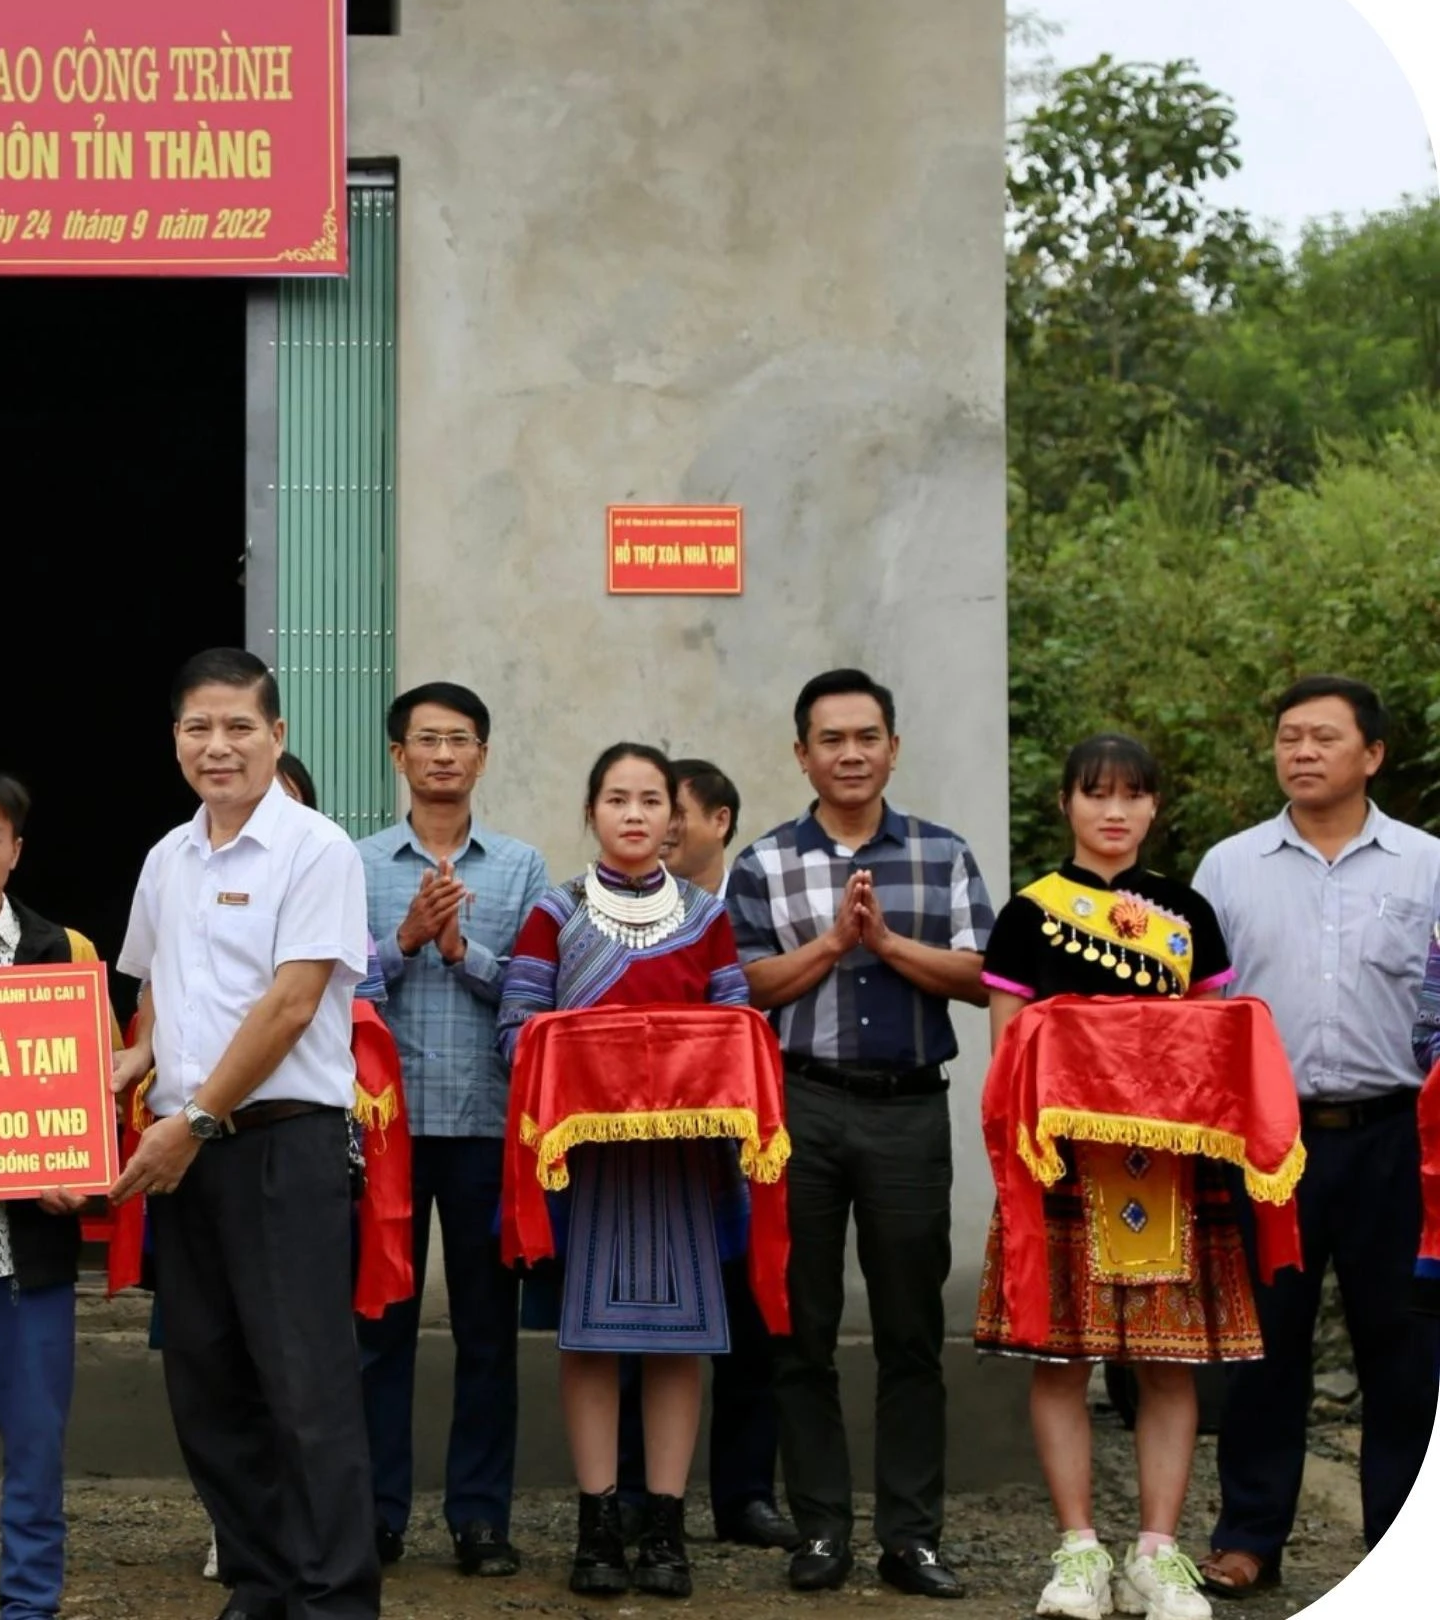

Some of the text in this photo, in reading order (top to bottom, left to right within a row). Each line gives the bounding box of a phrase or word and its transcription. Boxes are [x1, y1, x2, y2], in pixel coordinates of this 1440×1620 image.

[52, 28, 160, 104] CÔNG
[169, 29, 293, 102] TRÌNH
[71, 112, 133, 180] TỈN
[145, 120, 272, 180] THÀNG
[20, 209, 51, 240] 24
[62, 207, 129, 244] tháng
[130, 208, 149, 240] 9
[156, 208, 210, 240] năm
[211, 208, 272, 240] 2022
[29, 986, 52, 1003] LÀO
[54, 987, 75, 1002] CAI
[17, 1036, 77, 1084] TẠM
[35, 1108, 88, 1137] VNĐ
